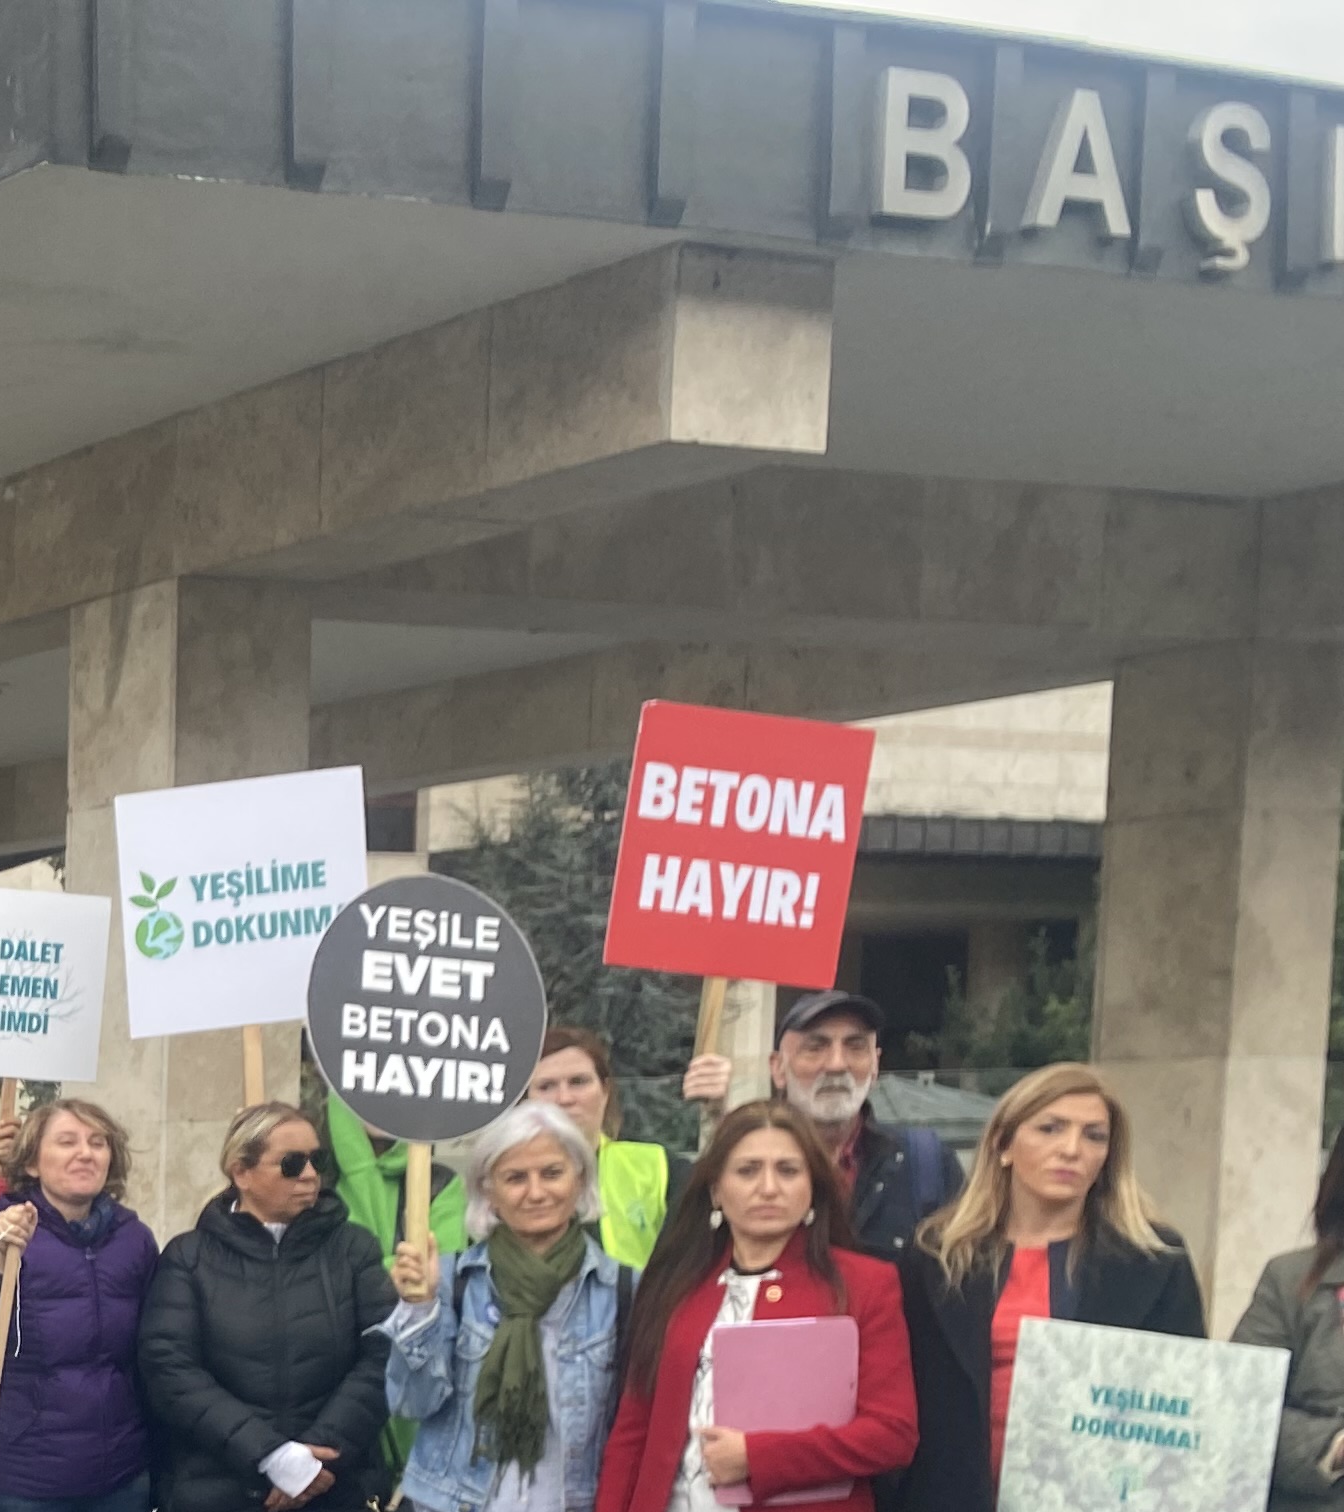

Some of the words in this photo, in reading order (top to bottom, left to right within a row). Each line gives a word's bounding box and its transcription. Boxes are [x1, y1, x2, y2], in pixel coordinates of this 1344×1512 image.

[638, 761, 846, 843] BETONA
[189, 859, 327, 907] YEŞİLİME
[638, 853, 820, 929] HAYIR!
[193, 903, 344, 948] DOKUNM
[359, 902, 502, 952] YEŞİLE
[362, 949, 495, 1002] EVET
[341, 1002, 510, 1053] BETONA
[341, 1049, 507, 1104] HAYIR!
[1072, 1413, 1201, 1450] DOKUNMA!
